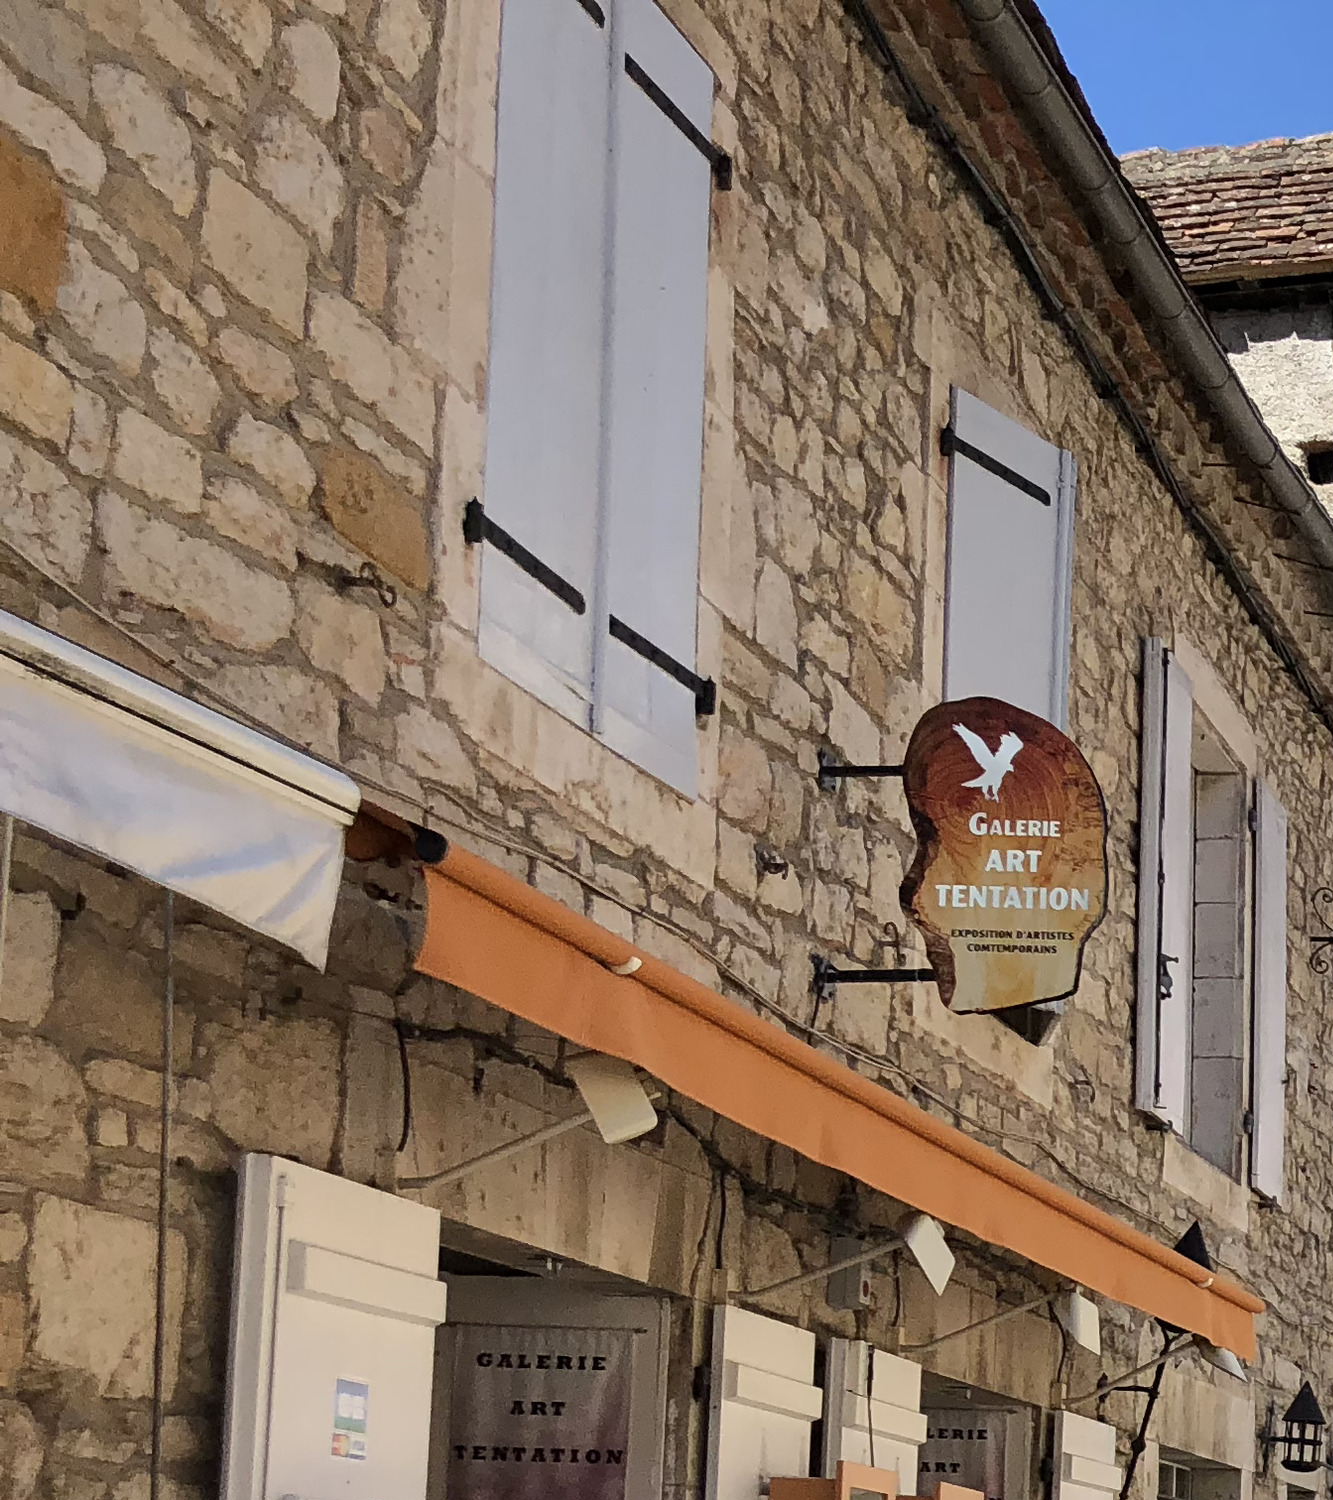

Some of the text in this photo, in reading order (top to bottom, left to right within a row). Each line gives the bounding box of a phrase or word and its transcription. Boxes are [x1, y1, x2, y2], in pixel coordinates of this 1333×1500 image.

[968, 811, 1061, 839] GALERIE
[984, 849, 1042, 874] ART
[935, 884, 1090, 912] TENTATION
[950, 928, 1075, 941] EXPOSITION D'ARTISTES
[475, 1350, 608, 1373] GALERIE
[509, 1399, 567, 1418] ART
[452, 1443, 626, 1466] TENTATION
[919, 1461, 961, 1474] ART
